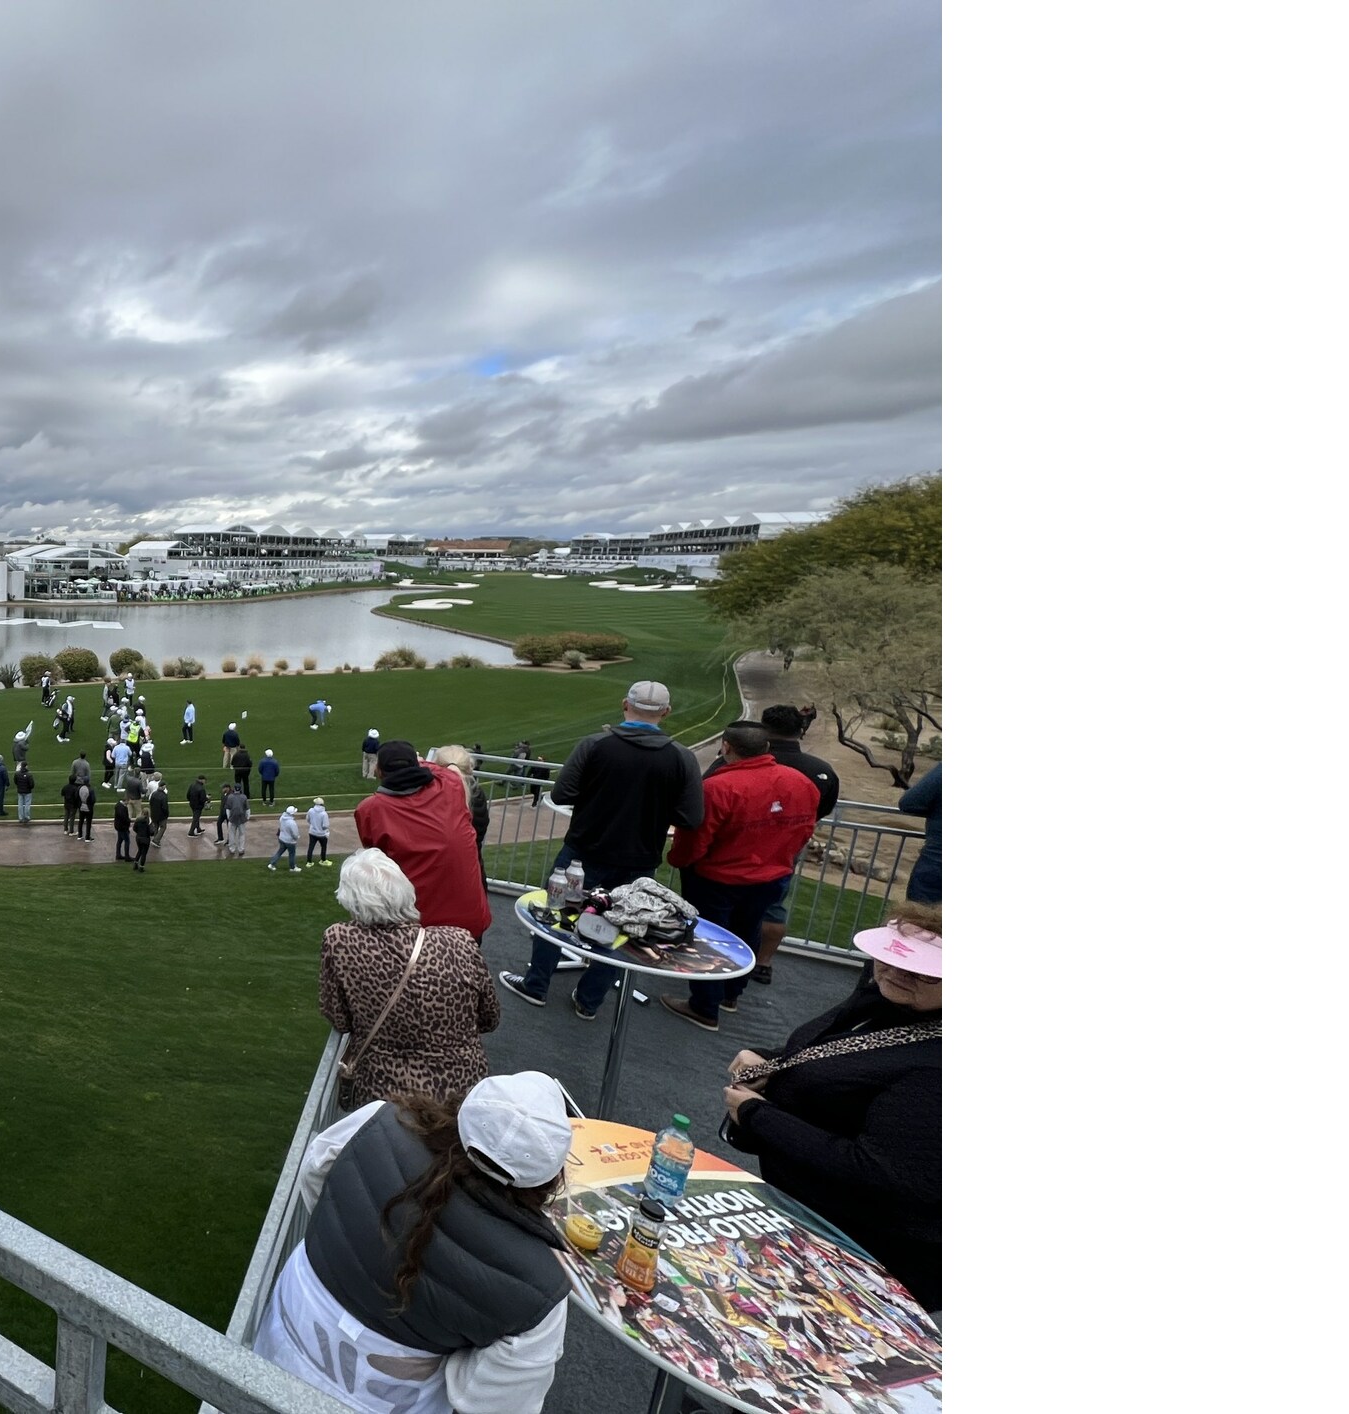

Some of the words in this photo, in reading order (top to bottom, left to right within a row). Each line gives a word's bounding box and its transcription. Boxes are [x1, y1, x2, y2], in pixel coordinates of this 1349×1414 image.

[674, 1188, 765, 1219] NORTH
[659, 1221, 717, 1250] FRO
[708, 1209, 795, 1239] HELLO
